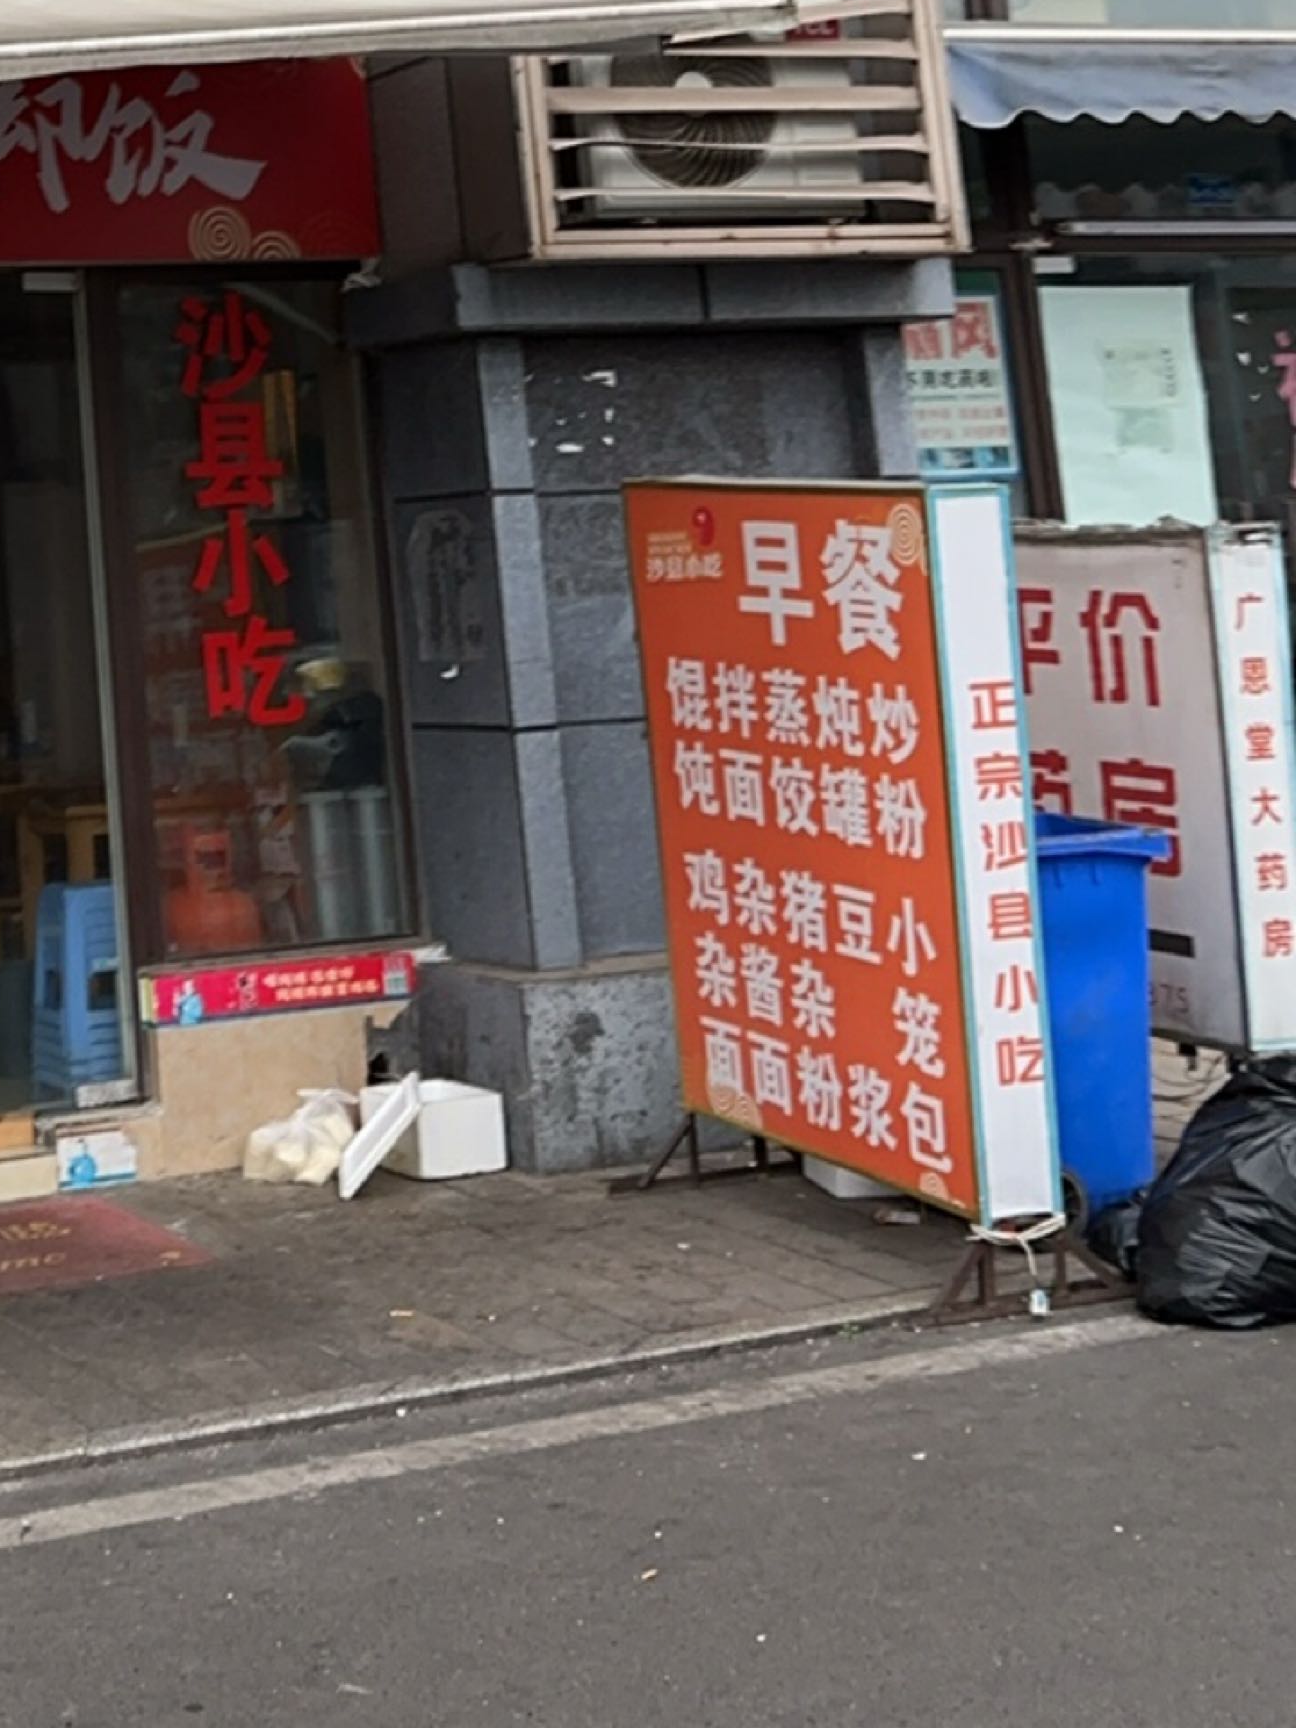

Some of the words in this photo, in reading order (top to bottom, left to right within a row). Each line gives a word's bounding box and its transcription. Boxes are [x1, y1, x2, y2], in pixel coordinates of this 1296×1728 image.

[174, 289, 307, 726] 沙县小吃
[738, 519, 903, 661] 早餐
[968, 681, 1045, 1088] 正宗沙县小吃
[1235, 593, 1294, 958] 广恩堂大药房
